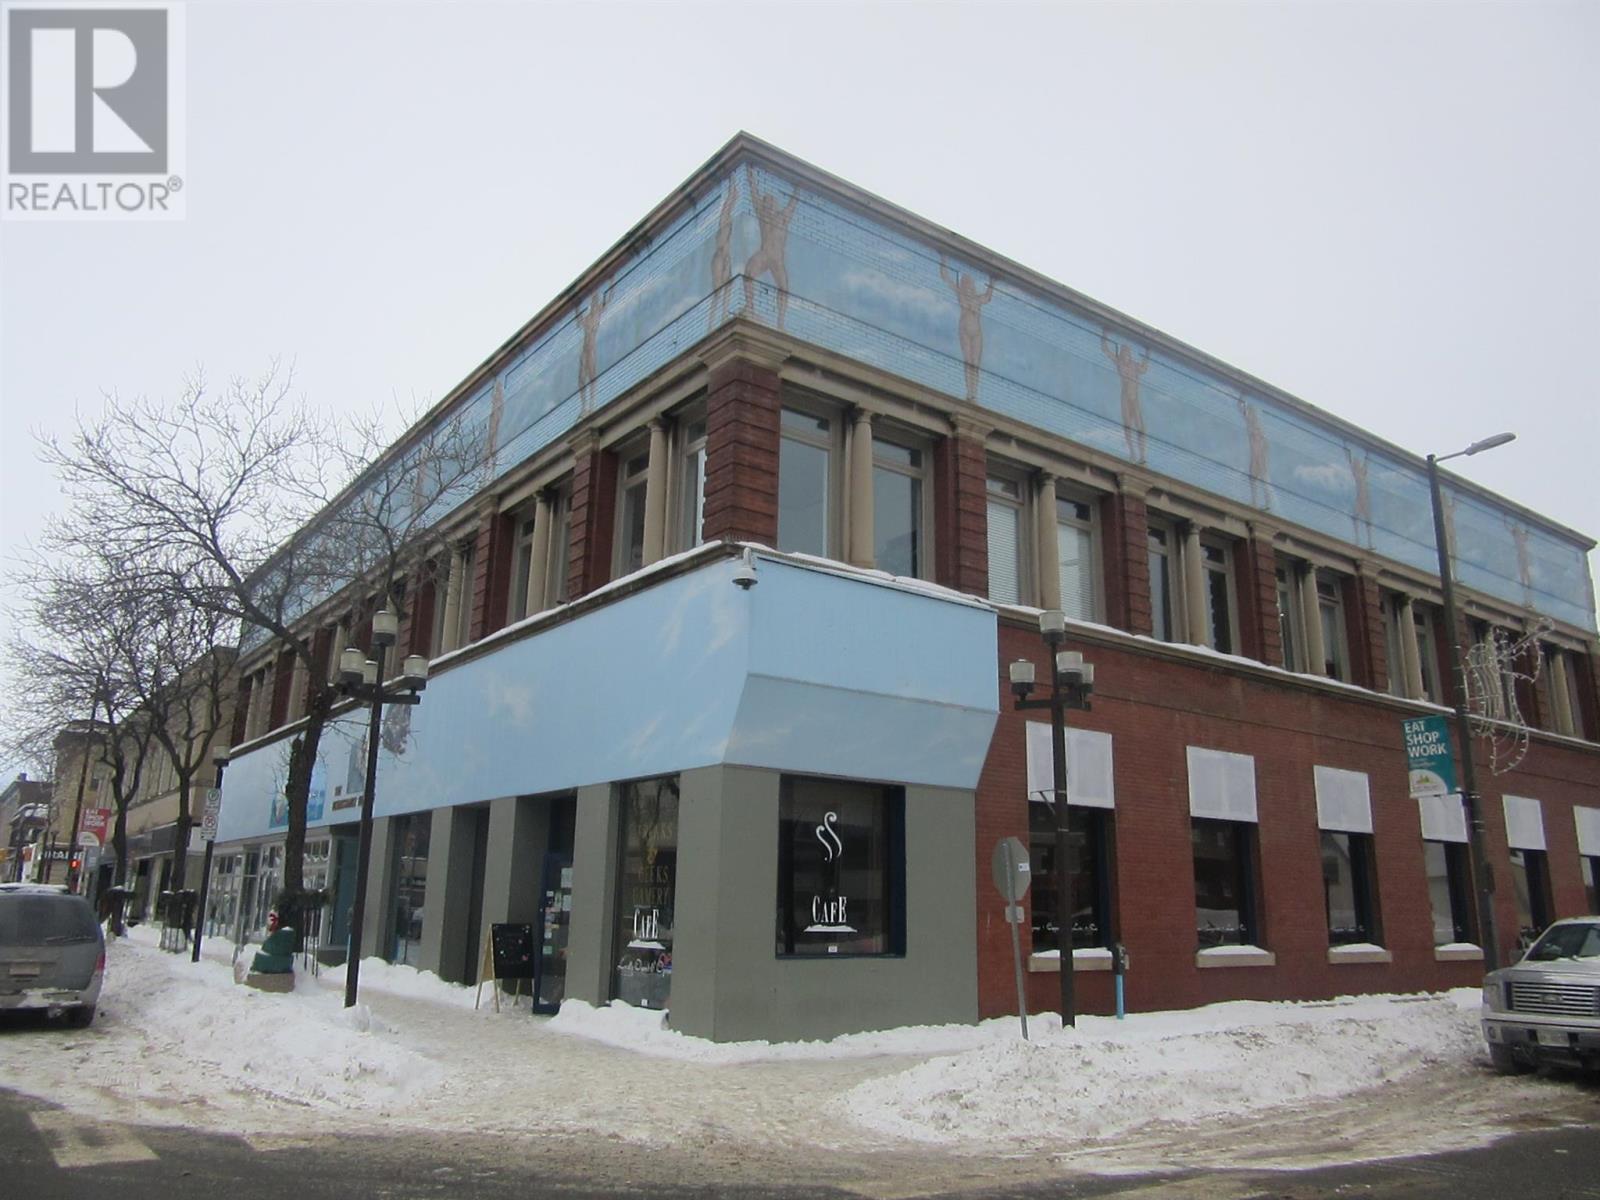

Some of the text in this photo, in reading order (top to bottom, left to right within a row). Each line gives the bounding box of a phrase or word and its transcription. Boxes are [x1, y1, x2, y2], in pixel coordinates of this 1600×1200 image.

[1404, 720, 1426, 733] EAT
[1405, 731, 1440, 746] SHOP
[1406, 743, 1447, 758] WORK
[812, 895, 847, 923] CAFE
